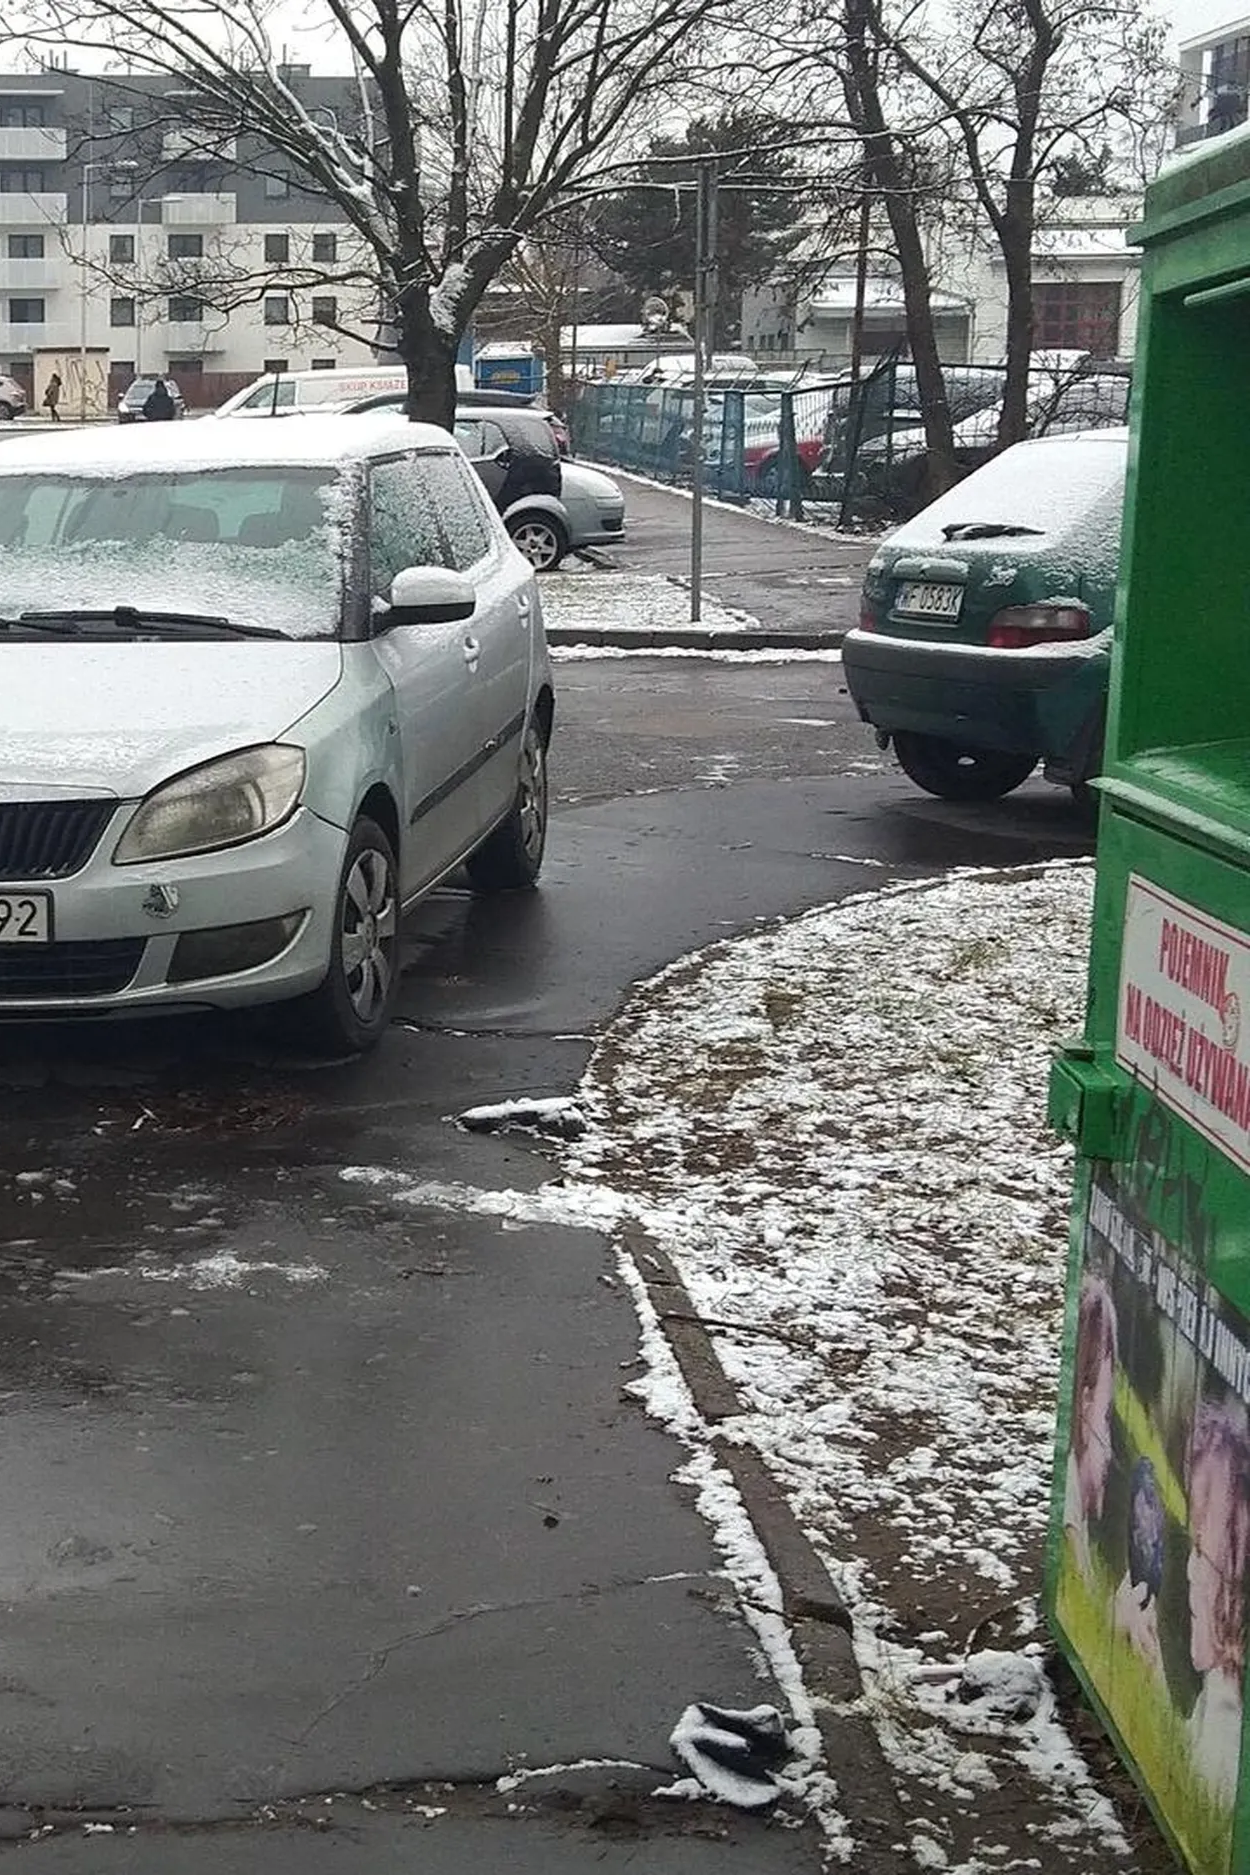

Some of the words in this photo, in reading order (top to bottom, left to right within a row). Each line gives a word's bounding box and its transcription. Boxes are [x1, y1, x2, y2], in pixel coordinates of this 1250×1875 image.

[921, 586, 963, 613] 0583K
[1159, 917, 1230, 1012] POJEMNIK
[1124, 983, 1143, 1044] NA
[1187, 1024, 1250, 1132] UŻYWAN
